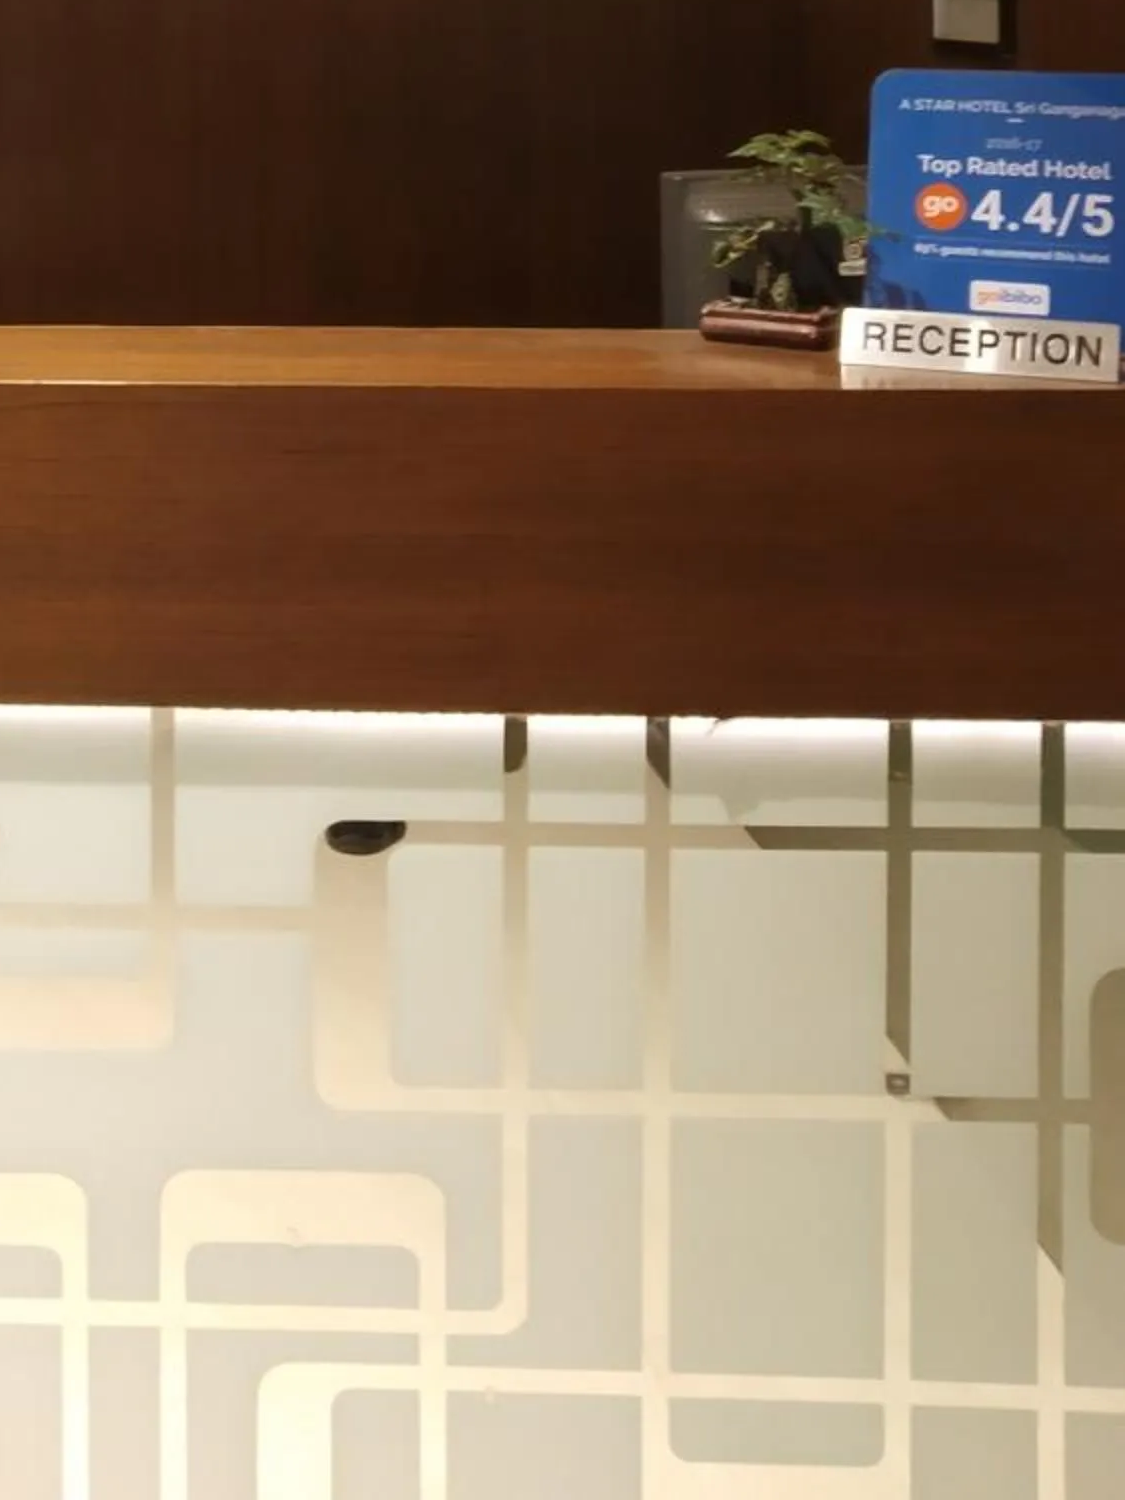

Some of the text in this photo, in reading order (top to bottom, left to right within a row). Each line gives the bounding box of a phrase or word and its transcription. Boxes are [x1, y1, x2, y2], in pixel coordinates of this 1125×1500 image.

[899, 98, 912, 111] A
[914, 98, 955, 112] STAR
[957, 99, 1011, 115] HOTEL
[917, 155, 1113, 181] Top Rated Hotel
[922, 189, 1115, 238] go 4.4/5
[976, 288, 1043, 307] goibibo
[862, 321, 1103, 366] RECEPTION
